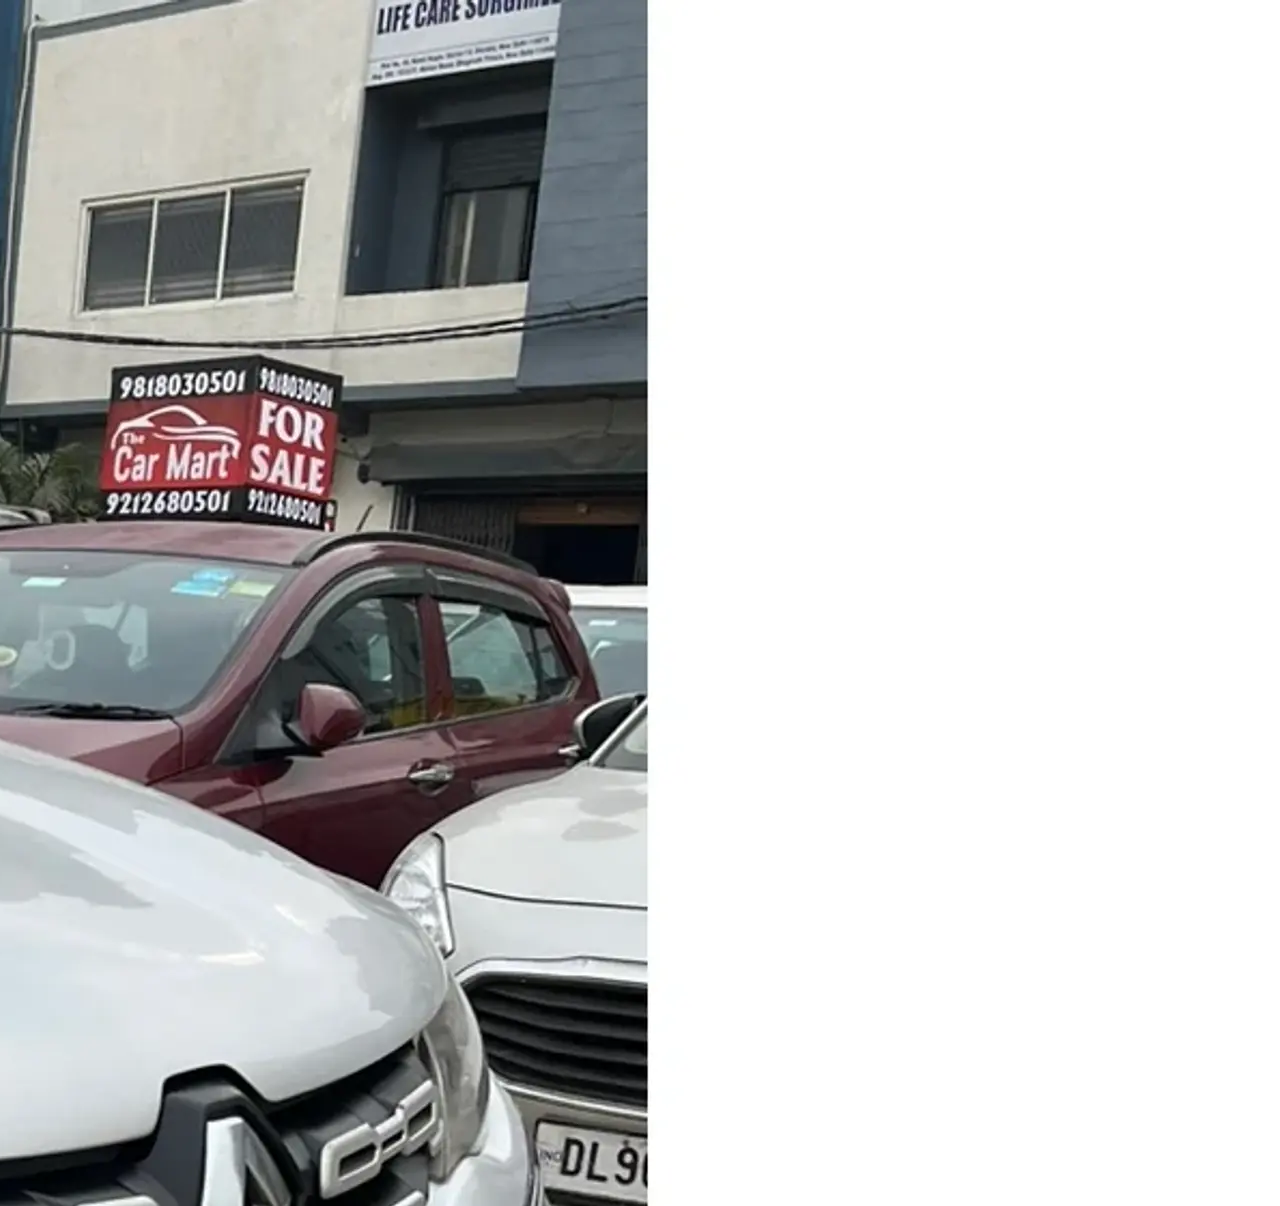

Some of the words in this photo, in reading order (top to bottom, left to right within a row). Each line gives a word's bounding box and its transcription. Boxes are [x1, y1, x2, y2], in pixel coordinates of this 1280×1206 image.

[377, 4, 412, 35] LIFE
[414, 0, 461, 28] CARE
[120, 370, 246, 399] 9818030501
[259, 366, 334, 408] 9818030501
[122, 432, 145, 445] The
[258, 398, 325, 451] FOR
[113, 445, 160, 483] Car
[165, 443, 228, 481] Mart
[249, 443, 326, 495] SALE
[106, 489, 231, 515] 9212680501
[247, 488, 323, 525] 9212680501
